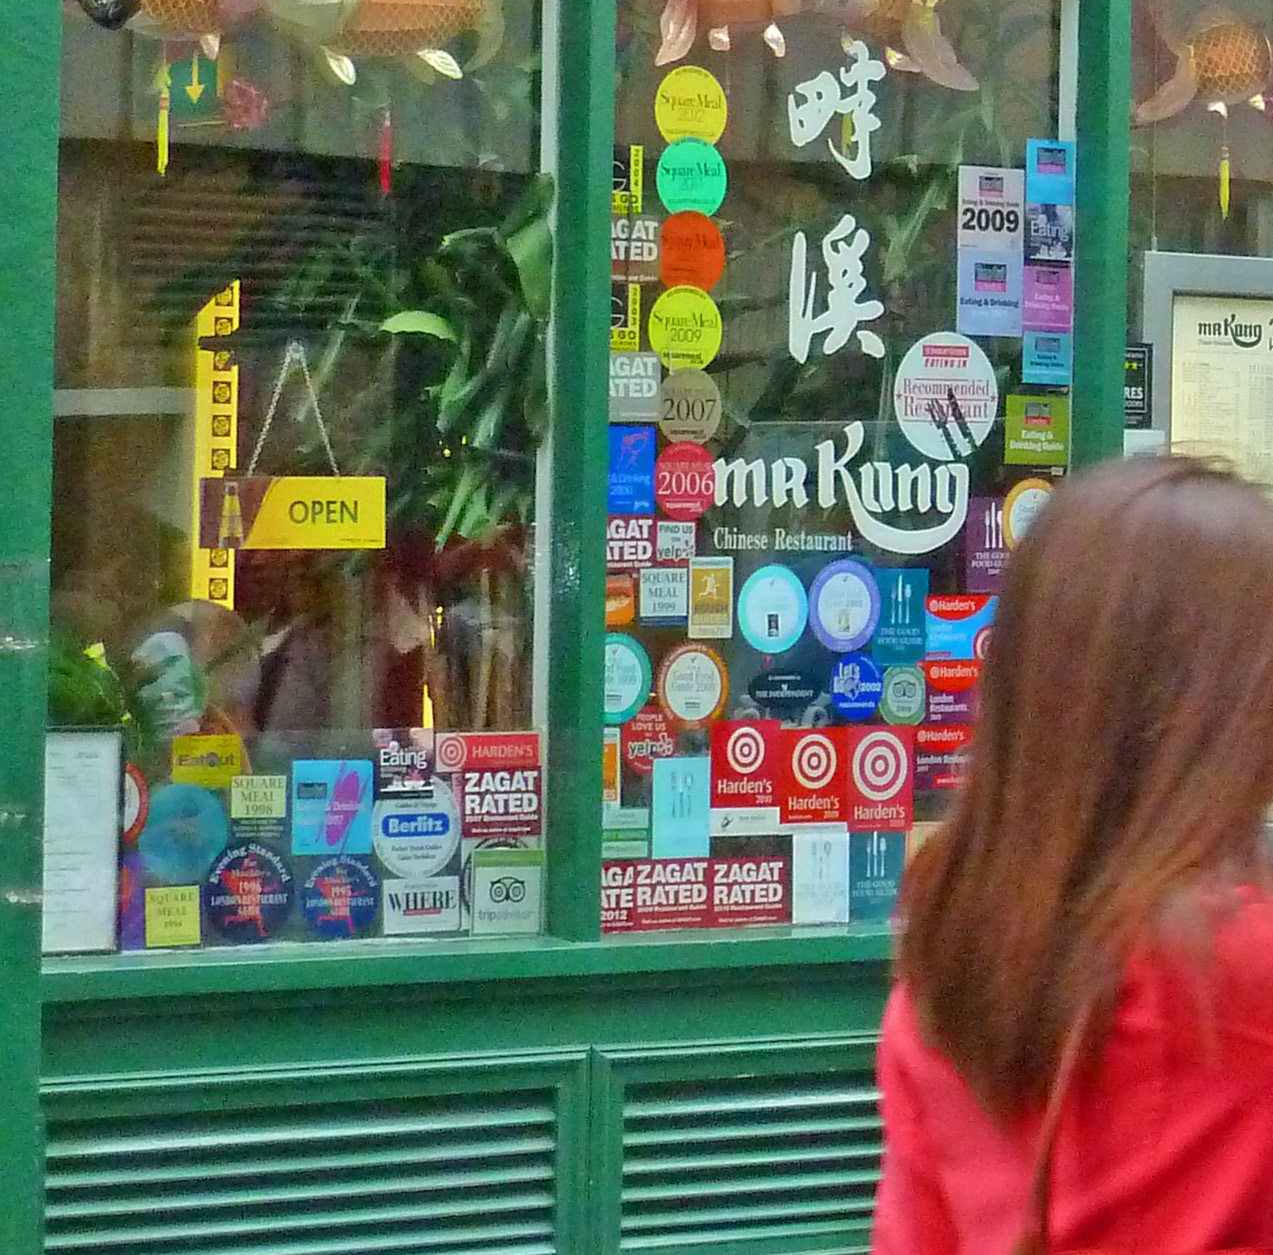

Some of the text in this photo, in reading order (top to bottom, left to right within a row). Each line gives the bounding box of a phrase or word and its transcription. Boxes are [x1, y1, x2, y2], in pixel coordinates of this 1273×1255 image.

[962, 207, 1019, 233] 2009
[1031, 221, 1069, 242] Eating
[960, 297, 982, 307] Eating
[670, 328, 702, 343] 2009
[662, 398, 717, 421] 2007
[658, 471, 714, 496] 2006
[288, 499, 359, 525] OPEN
[659, 525, 694, 534] FIND US
[713, 527, 853, 552] Chinese Restaurant
[642, 572, 685, 585] SQUARE
[649, 587, 679, 599] MEAL
[929, 599, 976, 612] @Harden's
[929, 665, 978, 679] @Harden's
[636, 713, 663, 721] PEOPLE
[631, 722, 667, 731] LOVE US
[917, 729, 965, 743] @Harden's
[379, 748, 428, 769] Eating
[472, 744, 534, 759] HARDEN'S
[233, 777, 285, 790] SQUARE
[465, 770, 538, 792] ZAGAT
[718, 778, 772, 794] Harden's
[240, 790, 277, 803] MEAL
[465, 793, 538, 815] RATED
[788, 794, 840, 810] Harden's
[244, 803, 273, 816] 1998
[854, 805, 905, 821] Harden's
[389, 816, 443, 834] Berlitz
[636, 862, 708, 885] ZAGAT
[714, 861, 783, 884] ZAGAT
[388, 889, 456, 912] WHERE
[636, 884, 708, 907] RATED
[714, 883, 783, 905] RATED
